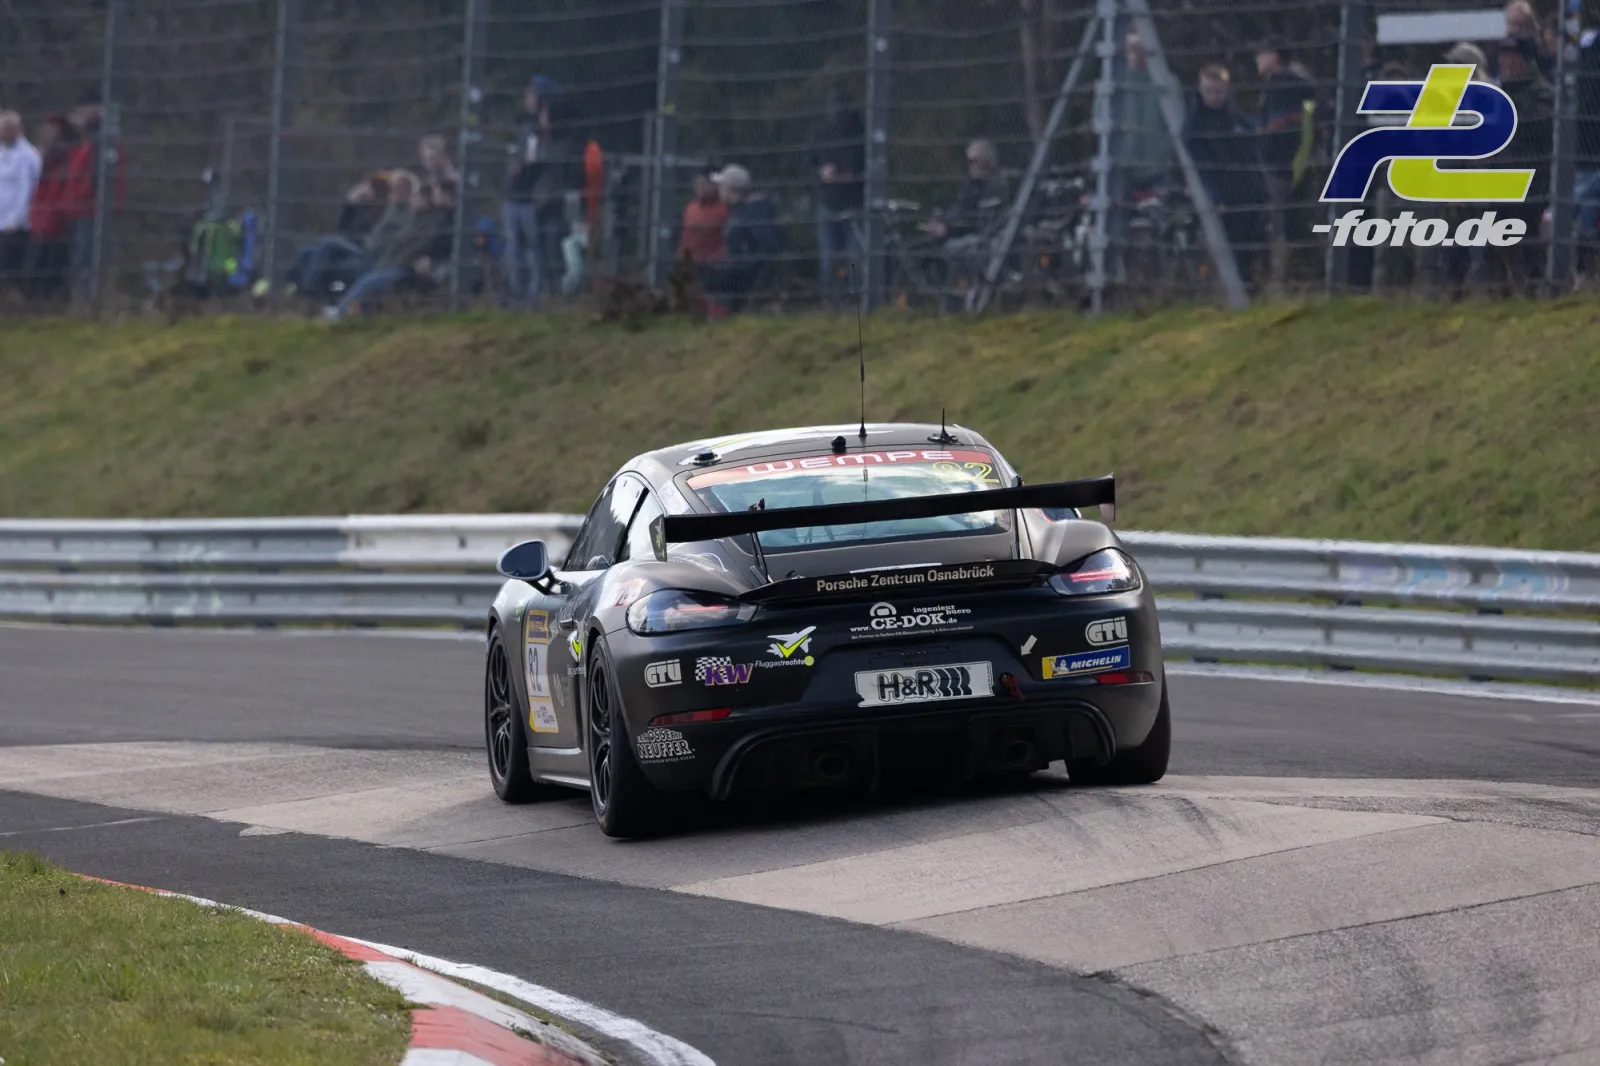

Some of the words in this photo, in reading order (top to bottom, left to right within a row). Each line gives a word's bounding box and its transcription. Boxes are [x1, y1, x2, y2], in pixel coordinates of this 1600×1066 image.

[746, 450, 954, 474] WEMPE
[816, 576, 868, 592] Porsche
[871, 573, 925, 587] Zentrum
[927, 565, 995, 583] Osnabrück
[912, 604, 956, 614] ingenieur
[1085, 616, 1128, 645] GTÜ
[528, 646, 543, 692] 82
[645, 659, 682, 687] GTÜ
[704, 662, 754, 686] KW
[1070, 655, 1122, 669] MICHELIN
[876, 668, 938, 701] H&R
[637, 740, 693, 759] NEUFFER
